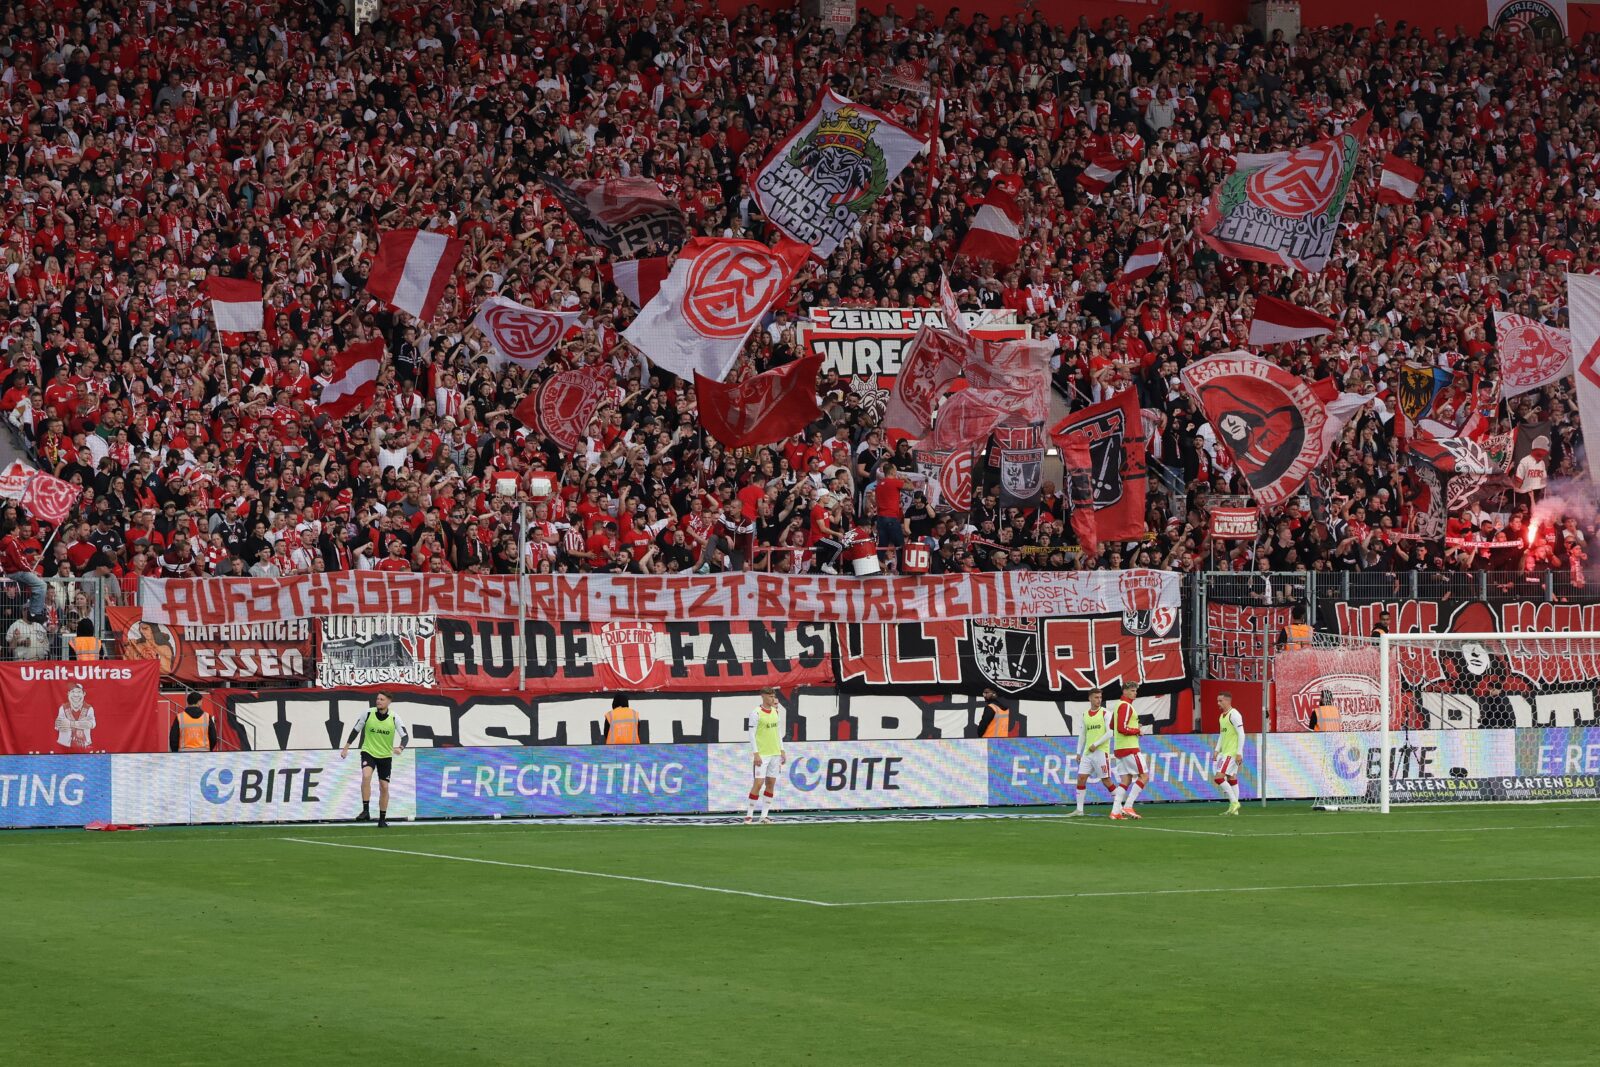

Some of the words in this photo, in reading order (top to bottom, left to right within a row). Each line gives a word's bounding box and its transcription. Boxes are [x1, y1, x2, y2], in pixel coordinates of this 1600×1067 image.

[1510, 1, 1550, 17] FRIENDS
[1214, 521, 1257, 533] ULTRAS
[608, 574, 745, 620] JETZT
[1208, 602, 1292, 632] SEKTIO
[439, 618, 594, 679] RUDE
[666, 619, 832, 678] FANS
[605, 630, 631, 646] RUDE
[633, 630, 655, 645] FANS
[20, 665, 132, 681] Uralt-Ultras
[195, 648, 304, 678] ESSEN
[376, 728, 390, 736] JAKO
[825, 757, 903, 791] BITE
[1366, 746, 1437, 780] BITE
[239, 767, 324, 804] BITE
[440, 762, 684, 798] E-RECRUITING
[1503, 777, 1596, 789] GARTENBAU
